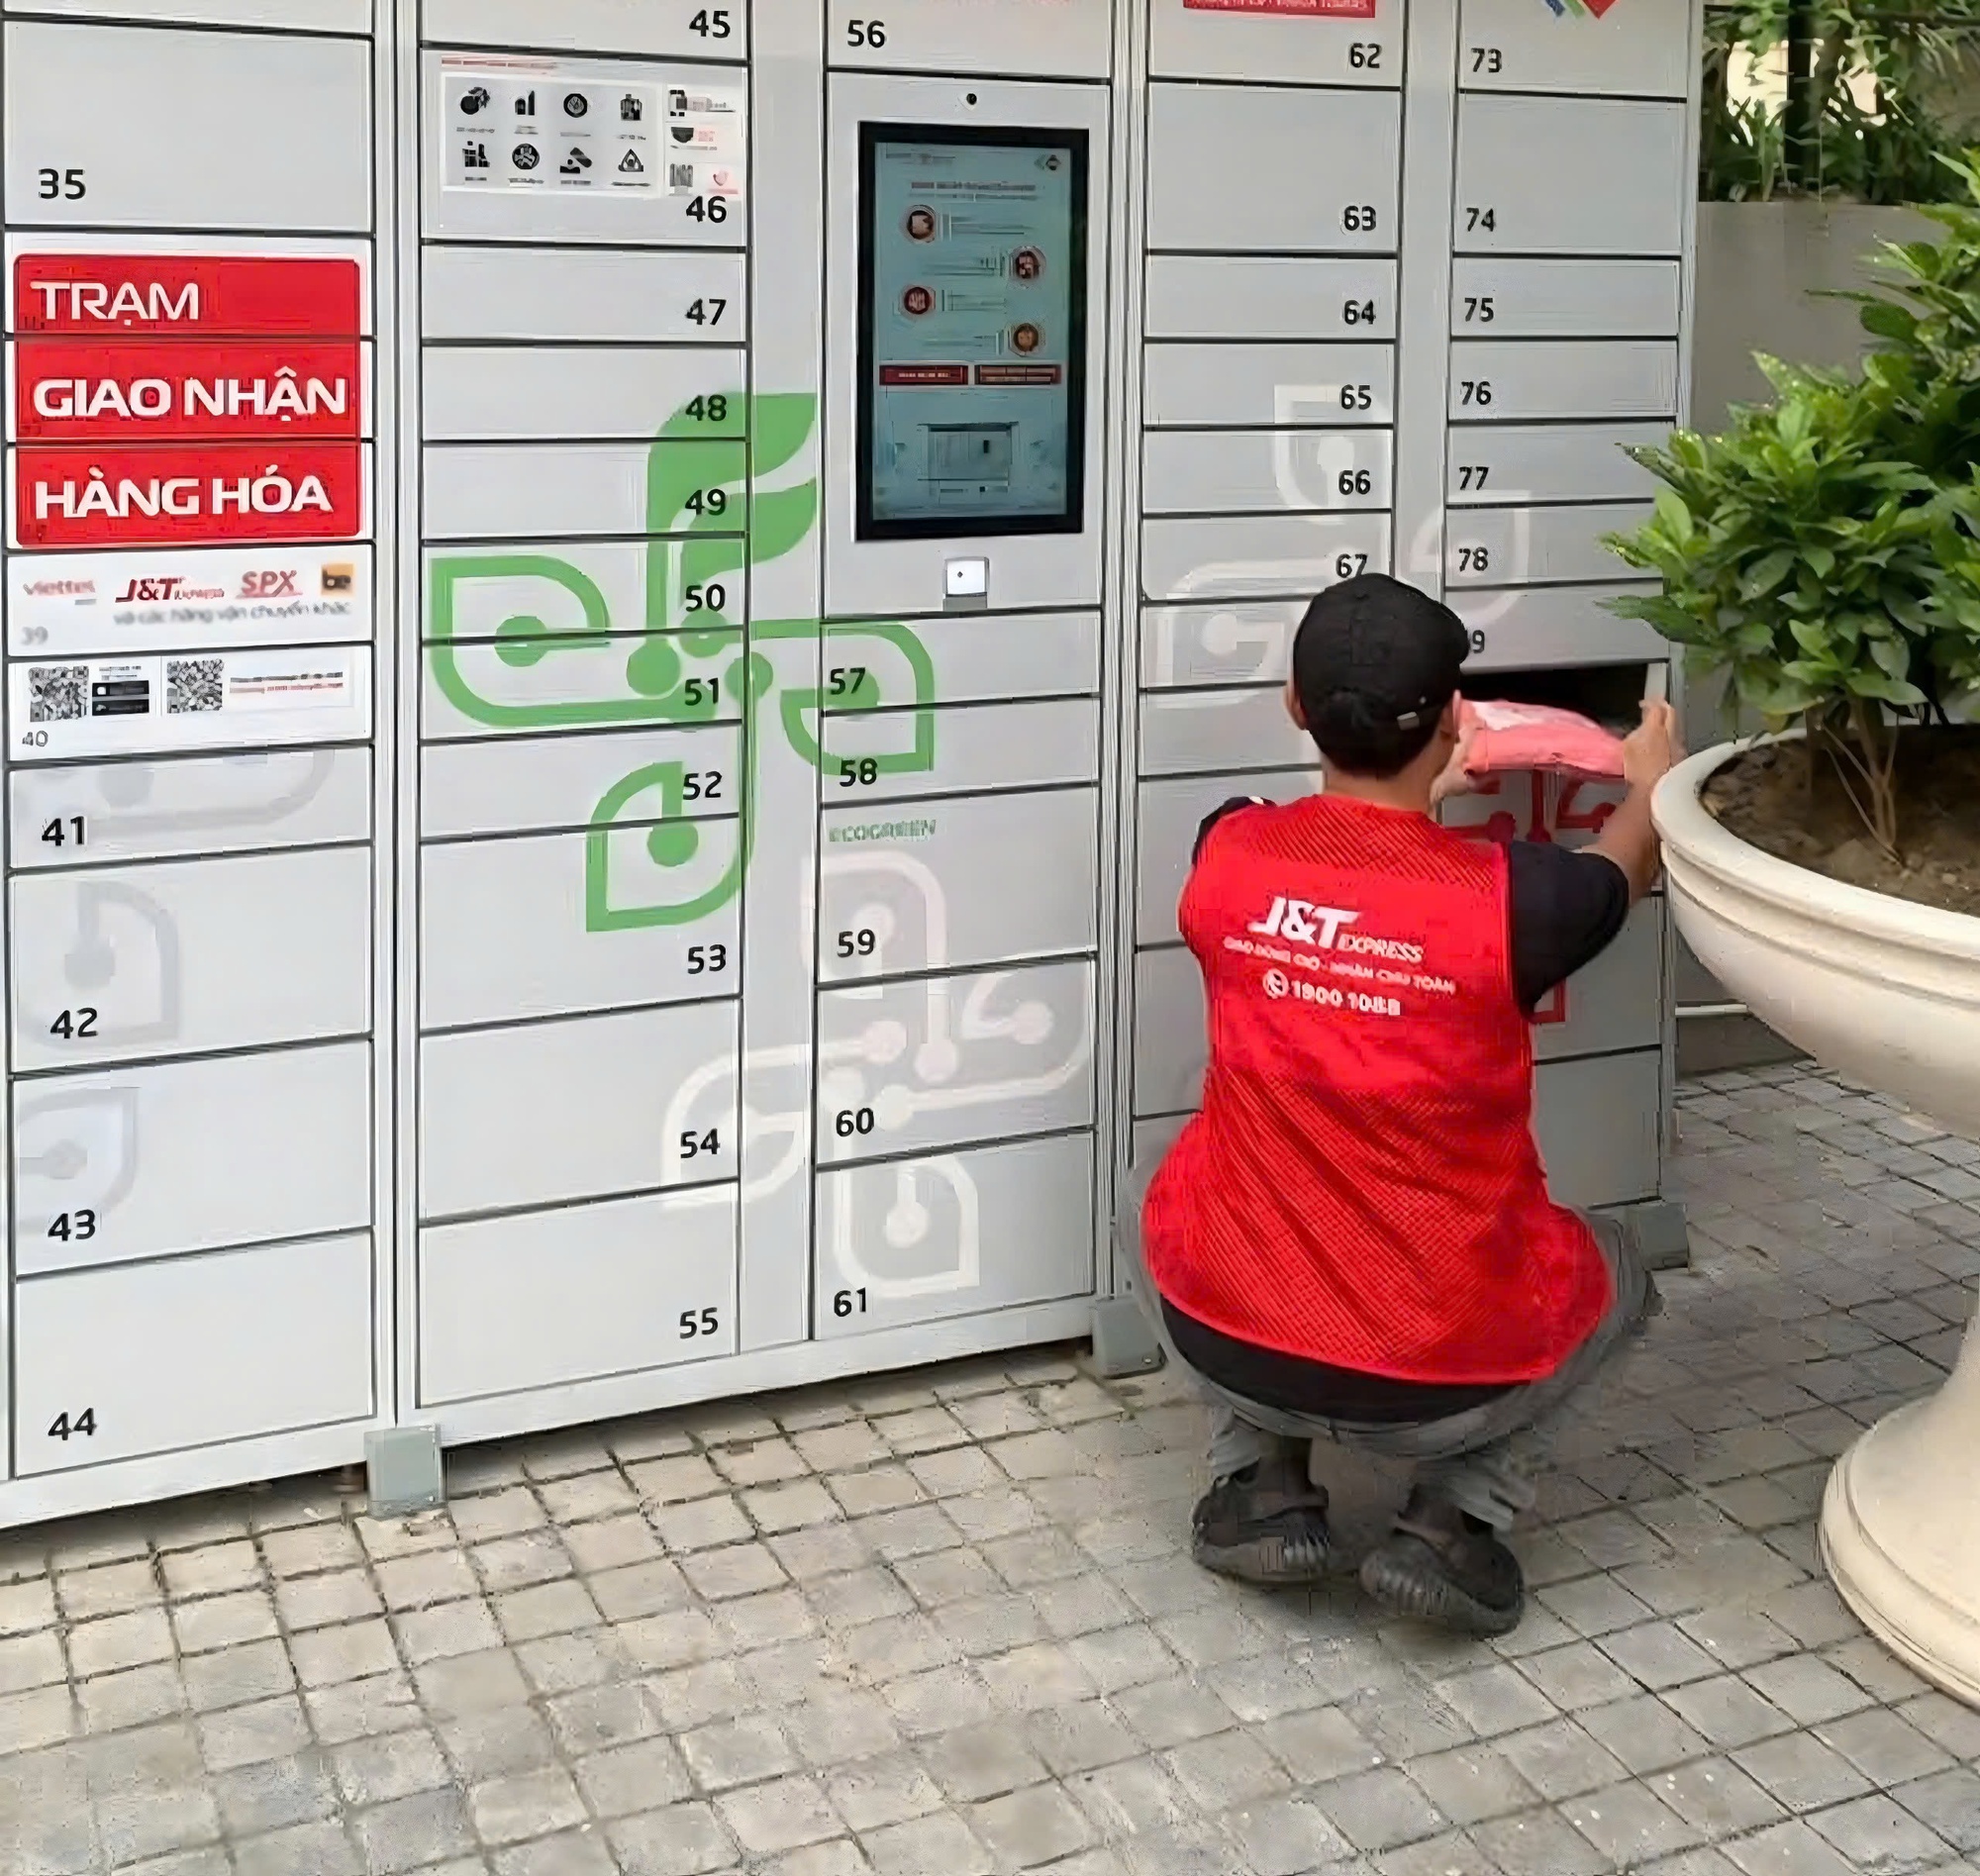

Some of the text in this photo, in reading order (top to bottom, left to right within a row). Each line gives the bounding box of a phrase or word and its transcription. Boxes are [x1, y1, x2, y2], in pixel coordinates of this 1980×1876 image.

[688, 9, 731, 39] 45
[847, 19, 886, 49] 56
[1349, 42, 1382, 69] 62
[1470, 48, 1503, 73] 73
[39, 168, 86, 200] 35
[685, 195, 728, 224] 46
[1343, 205, 1377, 232] 63
[1465, 207, 1496, 233] 74
[30, 281, 199, 327] TRẠM
[685, 298, 727, 326] 47
[1343, 299, 1377, 326] 64
[1464, 297, 1494, 323] 75
[33, 365, 346, 422] GIAO NHẬN
[684, 394, 728, 422] 48
[1340, 384, 1372, 411] 65
[1460, 380, 1492, 406] 76
[35, 463, 334, 520] HÀNG HÓA
[1338, 469, 1371, 496] 66
[1458, 465, 1490, 491] 77
[684, 488, 727, 516] 49
[1336, 552, 1368, 578] 67
[1458, 546, 1489, 572] 78
[241, 569, 298, 596] SPX
[685, 583, 726, 613] 50
[684, 677, 719, 707] 51
[830, 666, 866, 696] 57
[22, 729, 49, 746] 40
[682, 770, 723, 801] 52
[839, 757, 878, 788] 58
[41, 816, 84, 846] 41
[1246, 895, 1361, 949] J&T
[837, 929, 876, 958] 59
[687, 943, 727, 975] 53
[1290, 979, 1343, 1007] 1900
[50, 1007, 98, 1039] 42
[836, 1107, 875, 1137] 60
[680, 1128, 721, 1159] 54
[48, 1209, 96, 1241] 43
[834, 1287, 866, 1318] 61
[679, 1307, 719, 1339] 55
[48, 1407, 97, 1441] 44
